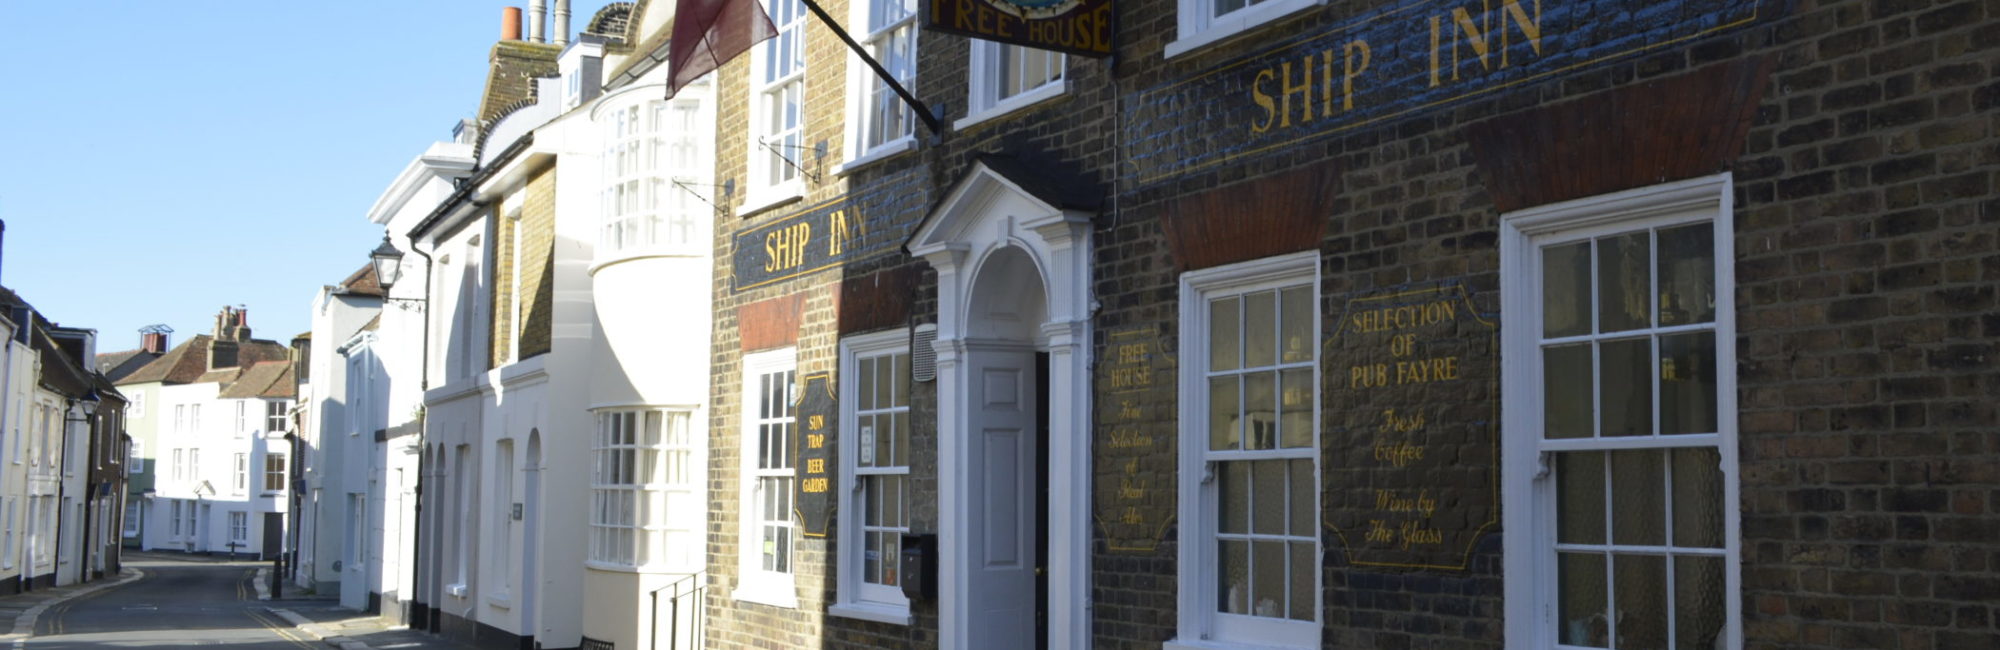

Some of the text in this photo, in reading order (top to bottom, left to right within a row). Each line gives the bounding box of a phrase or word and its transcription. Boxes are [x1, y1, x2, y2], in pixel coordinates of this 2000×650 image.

[1030, 2, 1111, 53] HOUSE
[1252, 0, 1541, 133] SHIP INN
[765, 200, 867, 273] SHIP INN
[1353, 300, 1456, 333] SELECTION
[1119, 344, 1148, 364] FREE
[1390, 333, 1417, 358] OF
[1111, 366, 1151, 388] HOUSE
[1351, 355, 1460, 390] PUB FAYRE
[808, 415, 824, 431] SUN
[1378, 408, 1426, 433] Fresh
[807, 433, 825, 449] TRAP
[1109, 429, 1152, 448] Selection
[807, 458, 825, 475] BEER
[1375, 441, 1425, 467] Coffee
[802, 477, 829, 494] GARDEN
[1374, 488, 1436, 518] Wine by
[1364, 519, 1443, 549] The Glass
